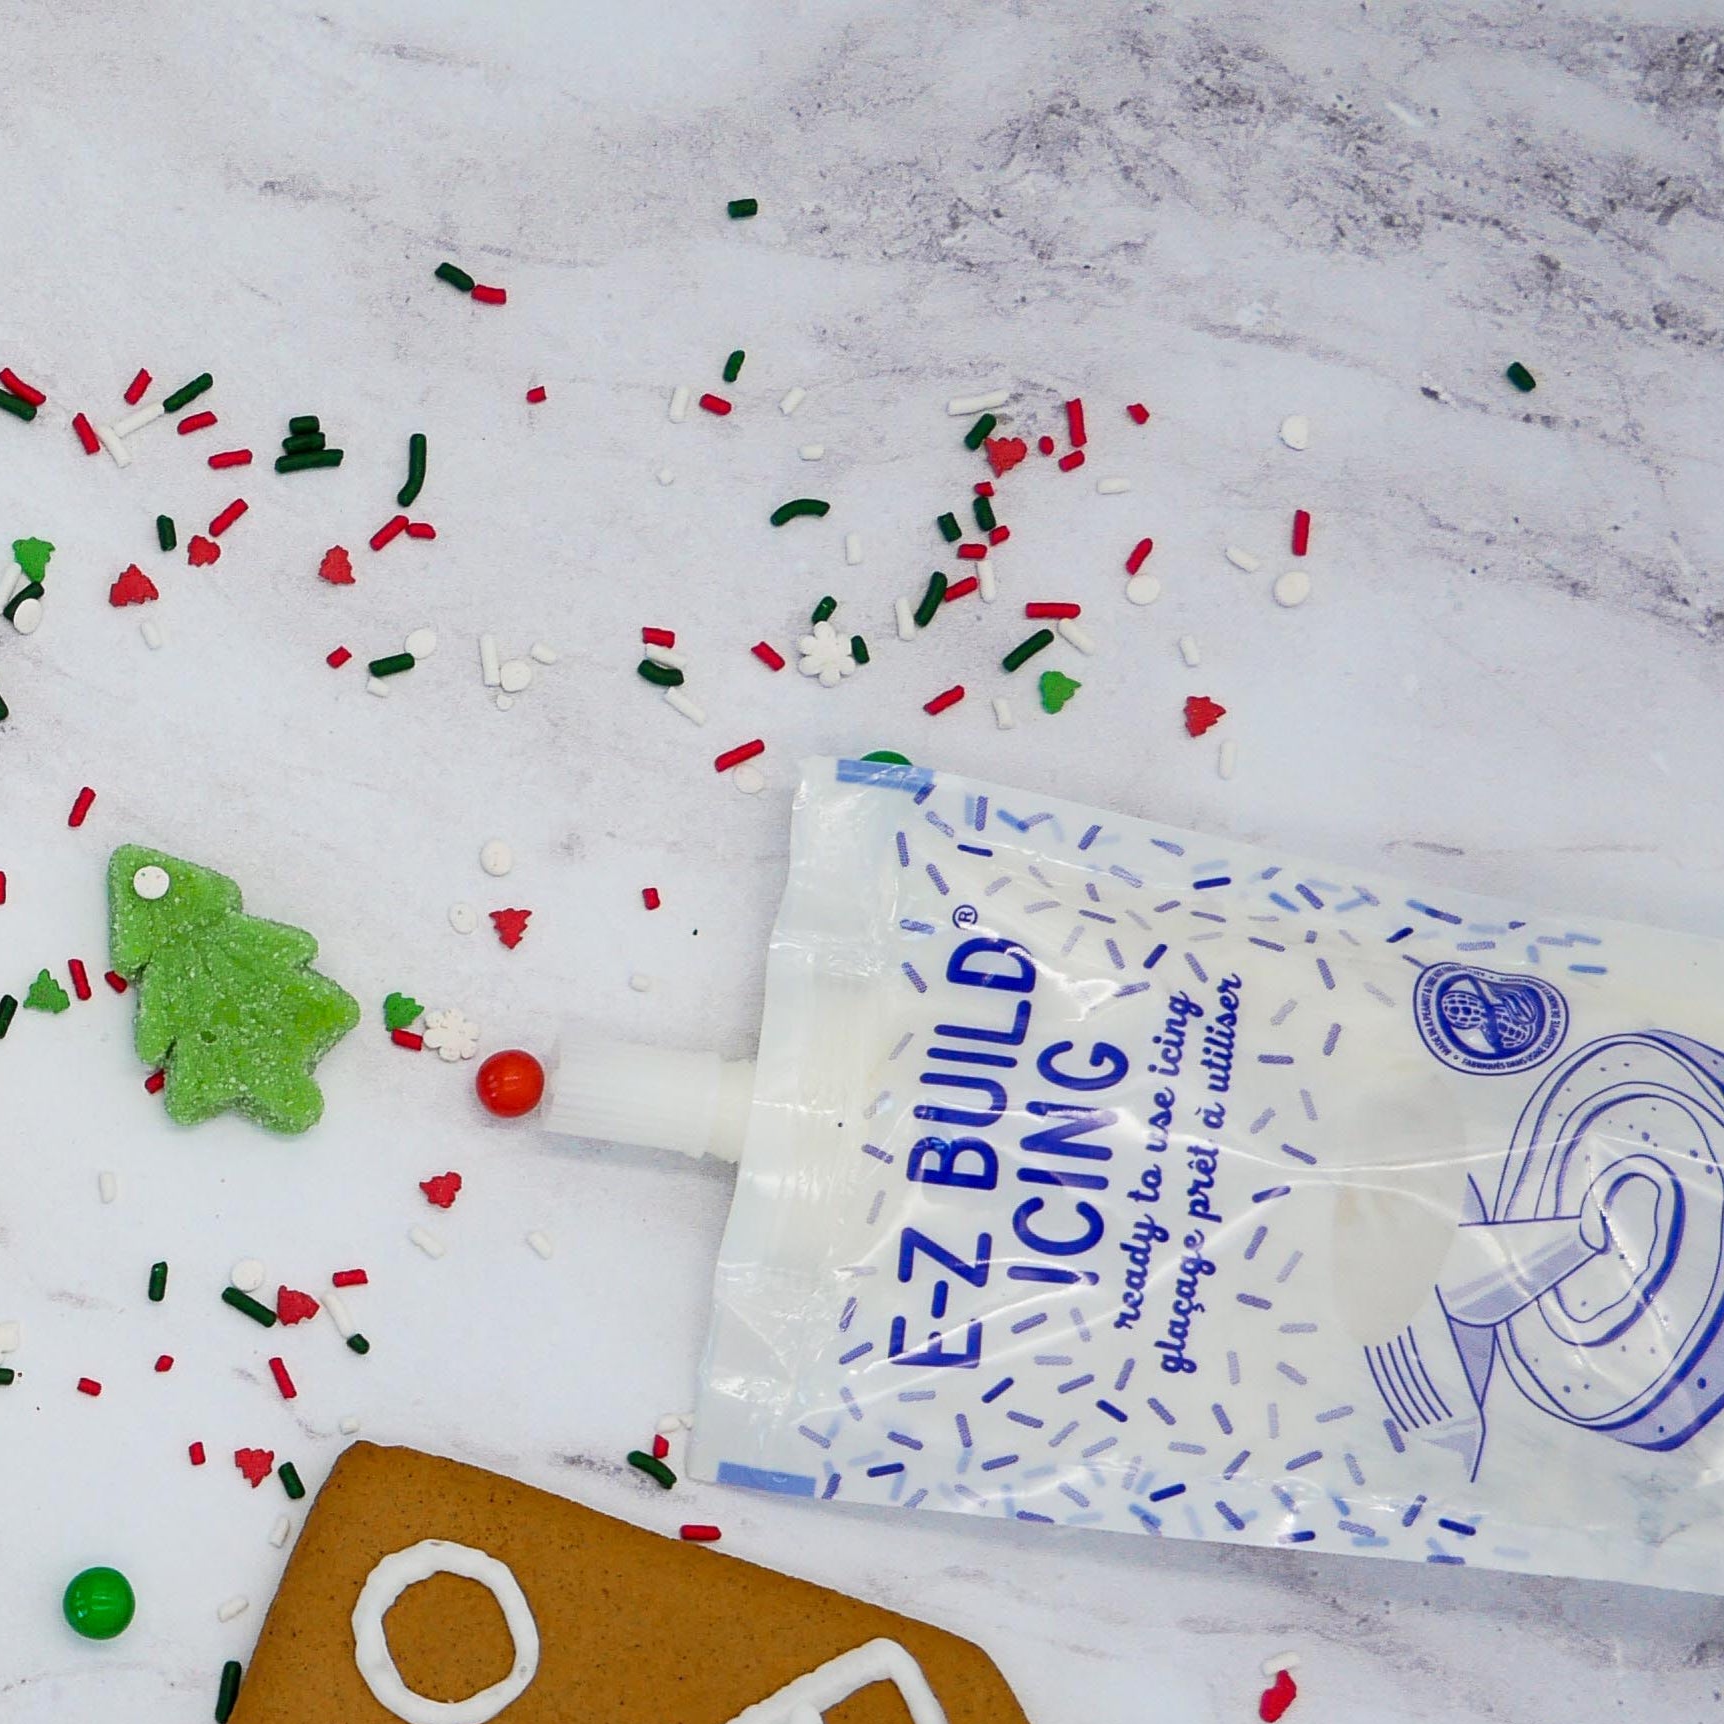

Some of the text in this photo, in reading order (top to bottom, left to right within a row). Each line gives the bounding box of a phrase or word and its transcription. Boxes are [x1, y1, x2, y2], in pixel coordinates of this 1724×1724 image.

[1007, 1040, 1129, 1286] ICING
[1114, 990, 1204, 1330] ready to use icing
[1431, 1034, 1452, 1057] MADE
[1154, 972, 1242, 1375] glaçage prêt à utiliser
[888, 1226, 992, 1369] E-Z
